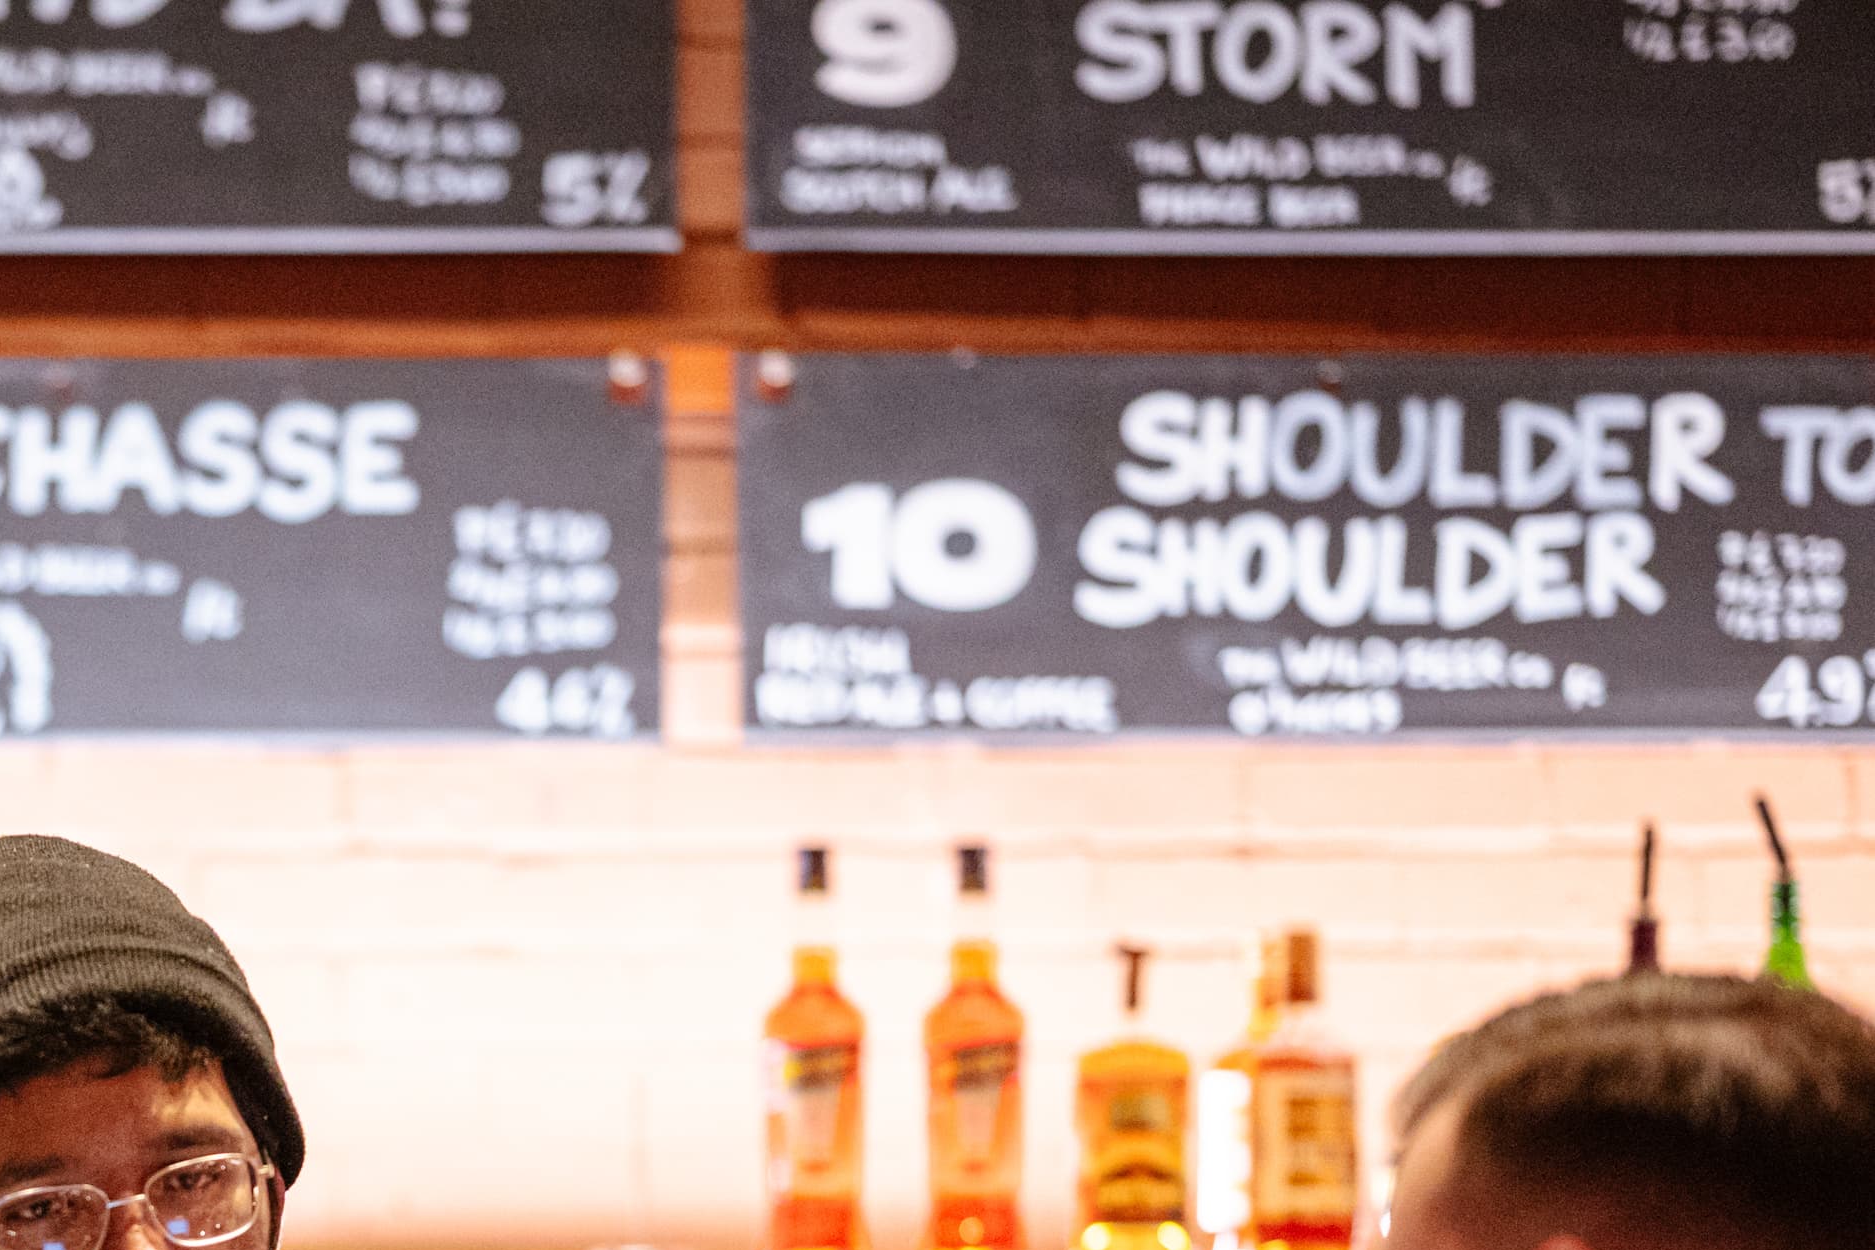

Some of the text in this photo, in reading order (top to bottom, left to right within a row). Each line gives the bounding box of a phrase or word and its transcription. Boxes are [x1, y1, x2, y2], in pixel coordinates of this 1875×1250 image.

[811, 0, 956, 108] 9
[1075, 0, 1475, 108] STORM
[1114, 389, 1875, 513] SHOULDER TO
[800, 478, 1037, 613] 10
[1072, 504, 1670, 630] SHOULDER
[1753, 648, 1875, 732] 4.9
